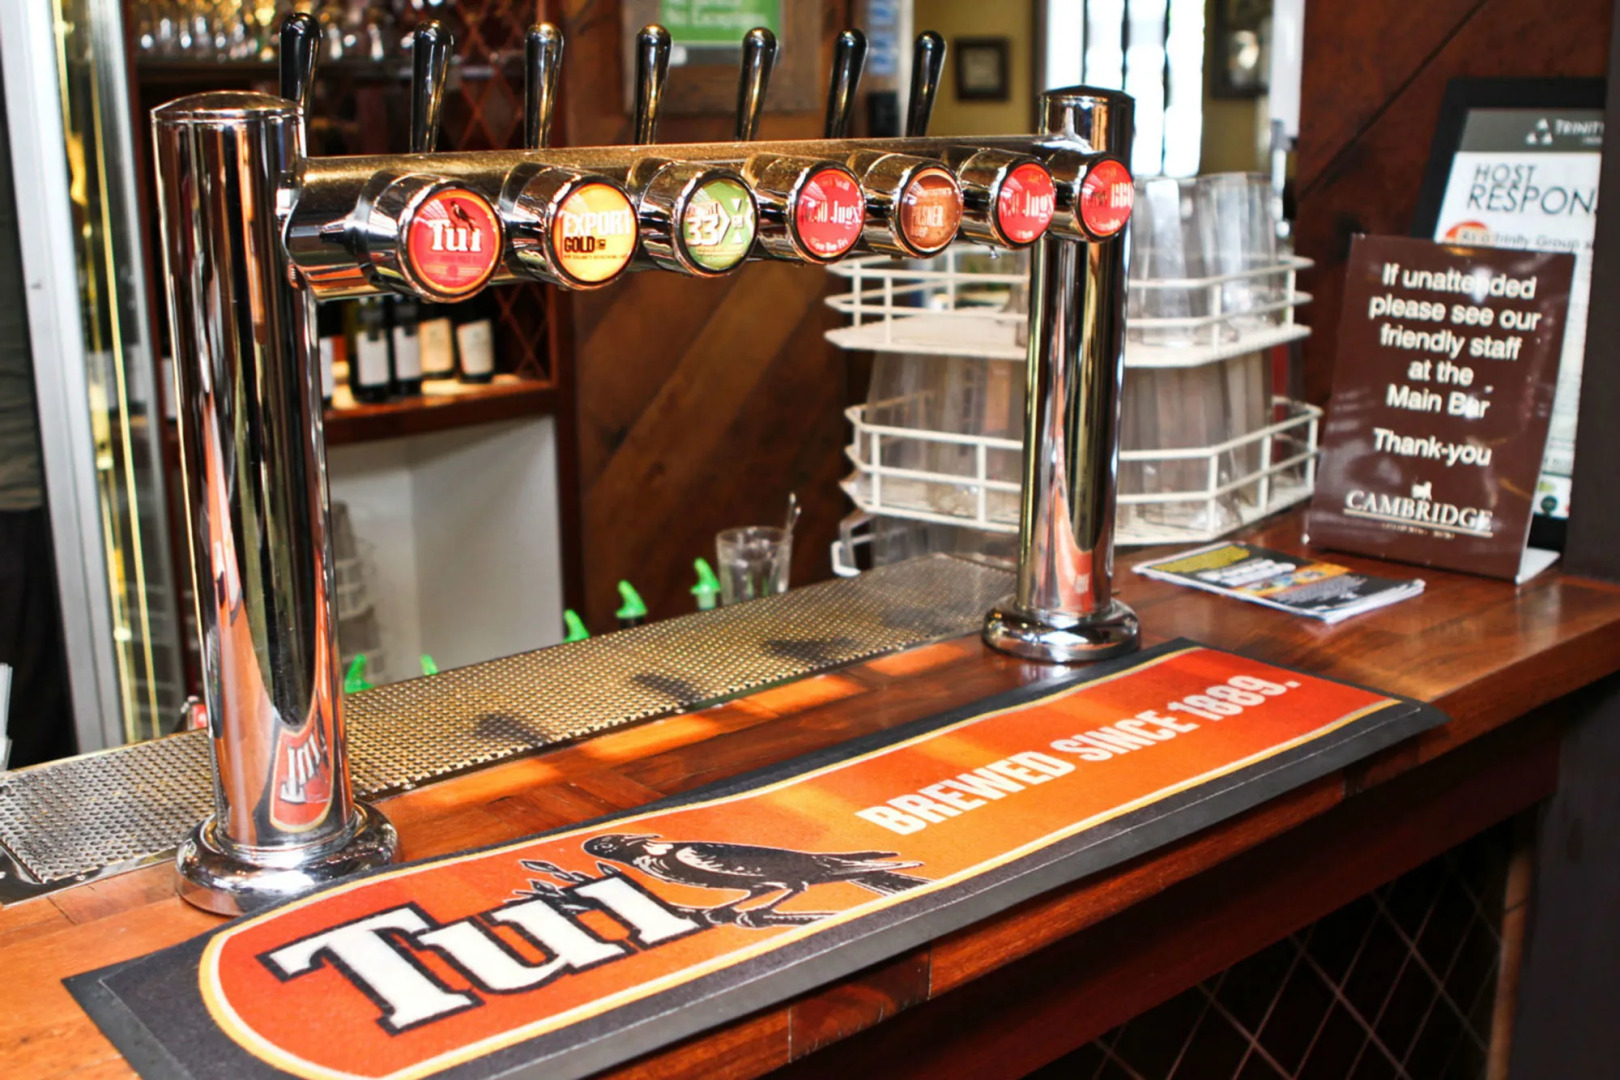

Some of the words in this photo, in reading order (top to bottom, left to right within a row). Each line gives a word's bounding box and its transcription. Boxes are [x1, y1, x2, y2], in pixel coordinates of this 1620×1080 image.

[1474, 164, 1537, 184] HOST
[427, 219, 482, 252] Tui
[563, 208, 631, 237] EXPORT
[685, 214, 720, 247] 33
[564, 236, 596, 253] GOLD
[1382, 263, 1400, 286] If
[1368, 294, 1446, 321] please
[1451, 304, 1494, 326] see
[1499, 308, 1542, 331] our
[1380, 322, 1465, 359] friendly
[1470, 335, 1523, 361] staff
[1408, 360, 1432, 381] at
[1436, 361, 1474, 386] the
[1386, 383, 1442, 412] Main
[1447, 391, 1490, 419] Bar
[1373, 427, 1492, 467] Thank-you
[1344, 490, 1494, 530] CAMBRIDGE
[854, 750, 1076, 836] BREWED
[1049, 709, 1200, 762] SINCE
[1168, 674, 1302, 722] 1889.
[260, 874, 710, 1034] Tui
